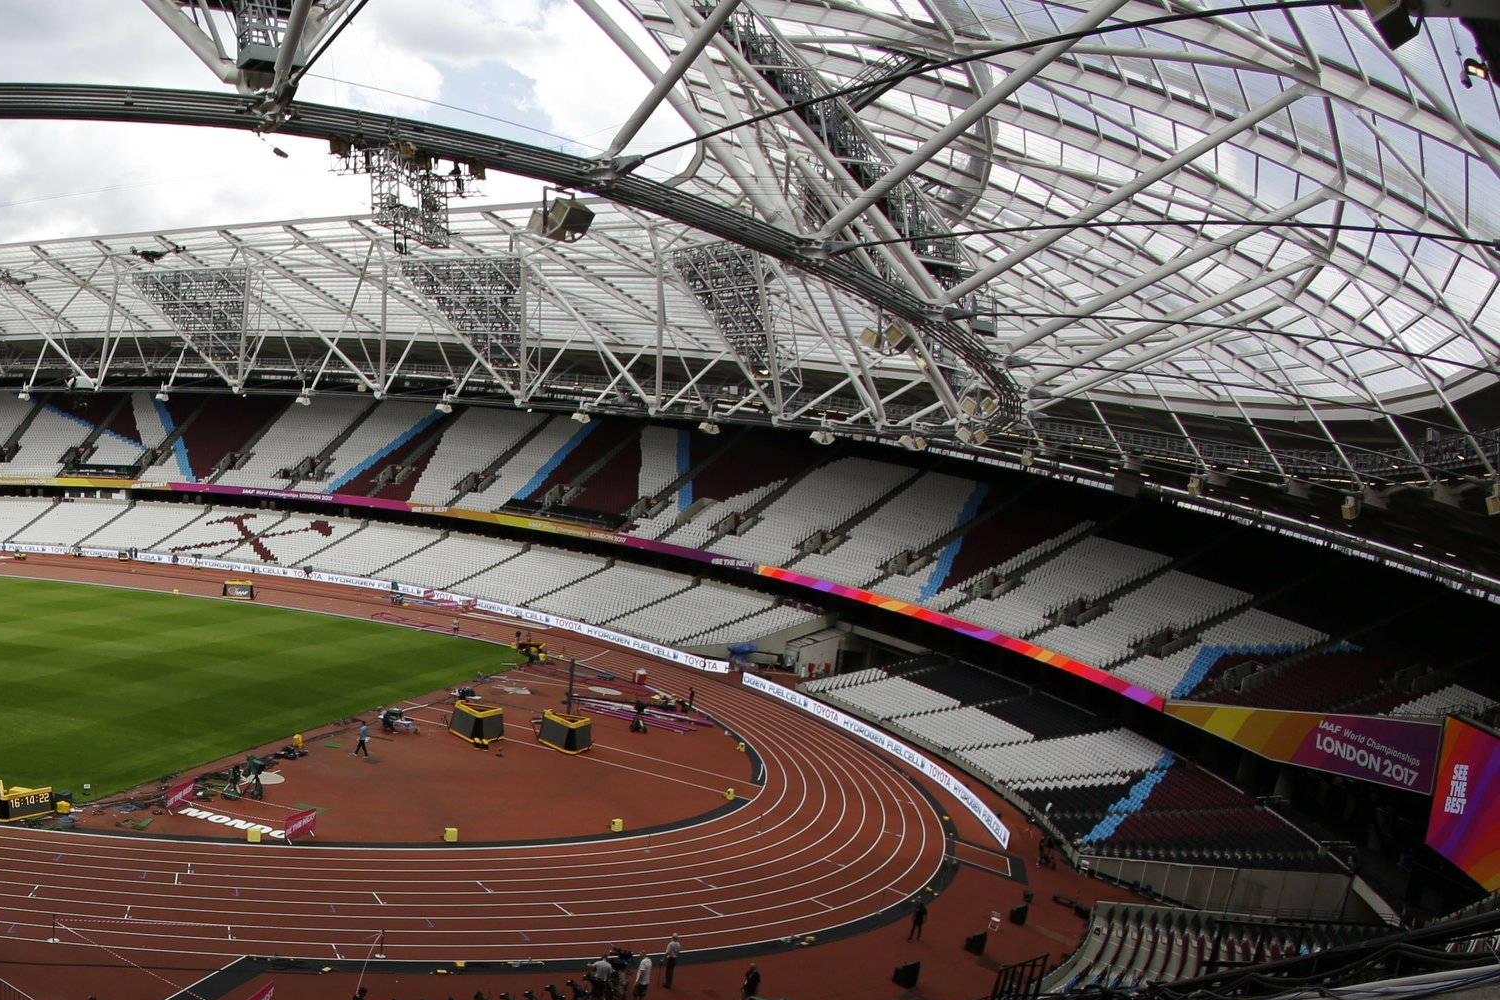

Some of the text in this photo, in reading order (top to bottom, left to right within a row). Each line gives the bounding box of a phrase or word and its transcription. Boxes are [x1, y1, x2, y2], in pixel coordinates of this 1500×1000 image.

[328, 575, 375, 588] HYDROGEN
[555, 618, 583, 631] TOYOTA
[588, 628, 630, 647] HYDROGEN
[684, 655, 719, 670] TOYOTA
[812, 703, 839, 722] TOYOTA
[843, 718, 884, 746] HYDROGEN
[929, 764, 951, 788] TOYOTA
[953, 785, 982, 816] HYDROGEN
[1316, 733, 1419, 787] LONDON 2017
[1319, 720, 1421, 767] IAAF World Championships
[1452, 763, 1469, 781] SEE
[10, 792, 50, 808] 16:14:22
[1444, 796, 1468, 815] BEST
[1450, 780, 1468, 798] THE
